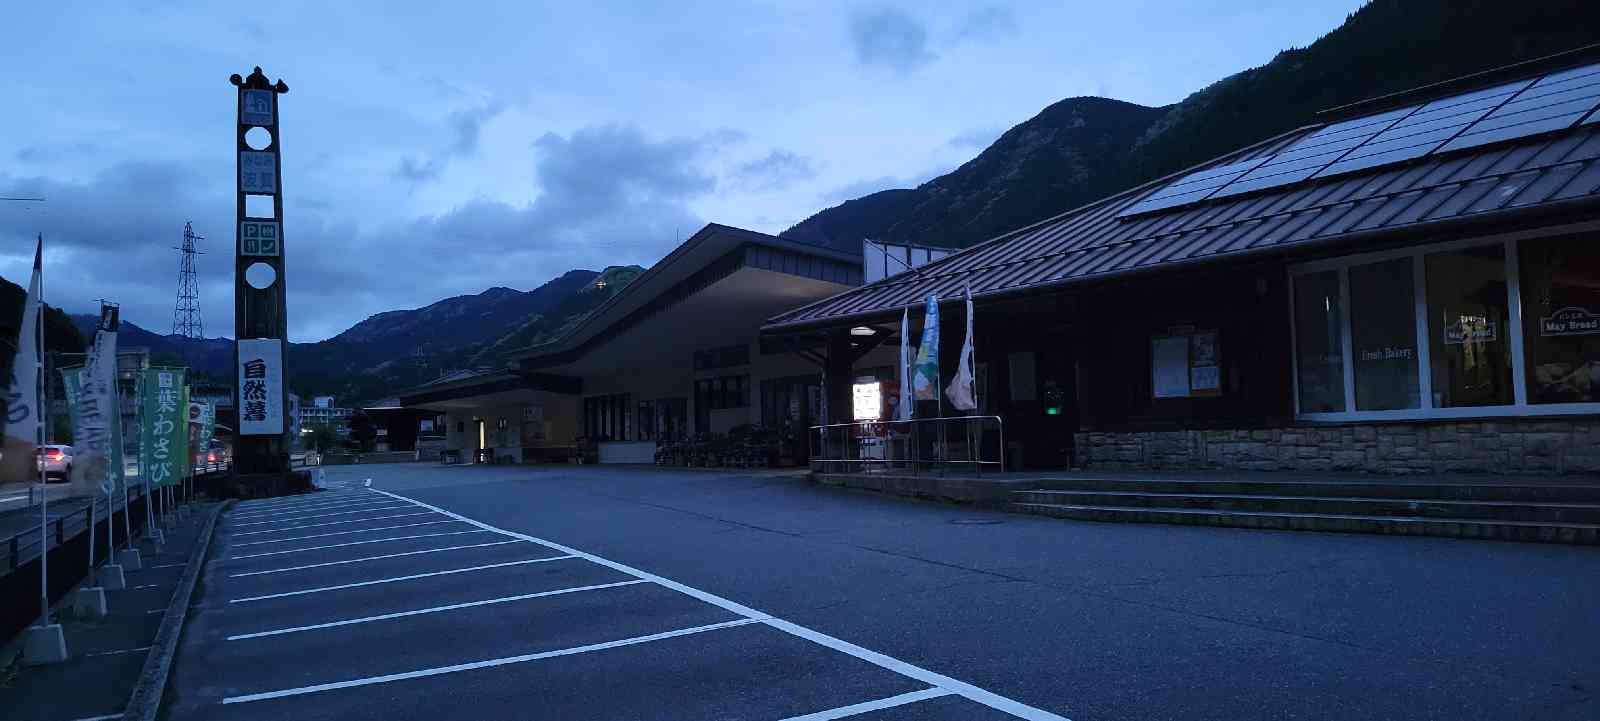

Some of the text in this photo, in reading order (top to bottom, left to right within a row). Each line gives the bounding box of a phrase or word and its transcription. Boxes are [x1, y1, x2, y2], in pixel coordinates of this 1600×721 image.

[247, 225, 257, 237] P
[1546, 319, 1599, 333] May Bread
[243, 359, 267, 421] 自然薯
[152, 388, 177, 482] 葉わさび
